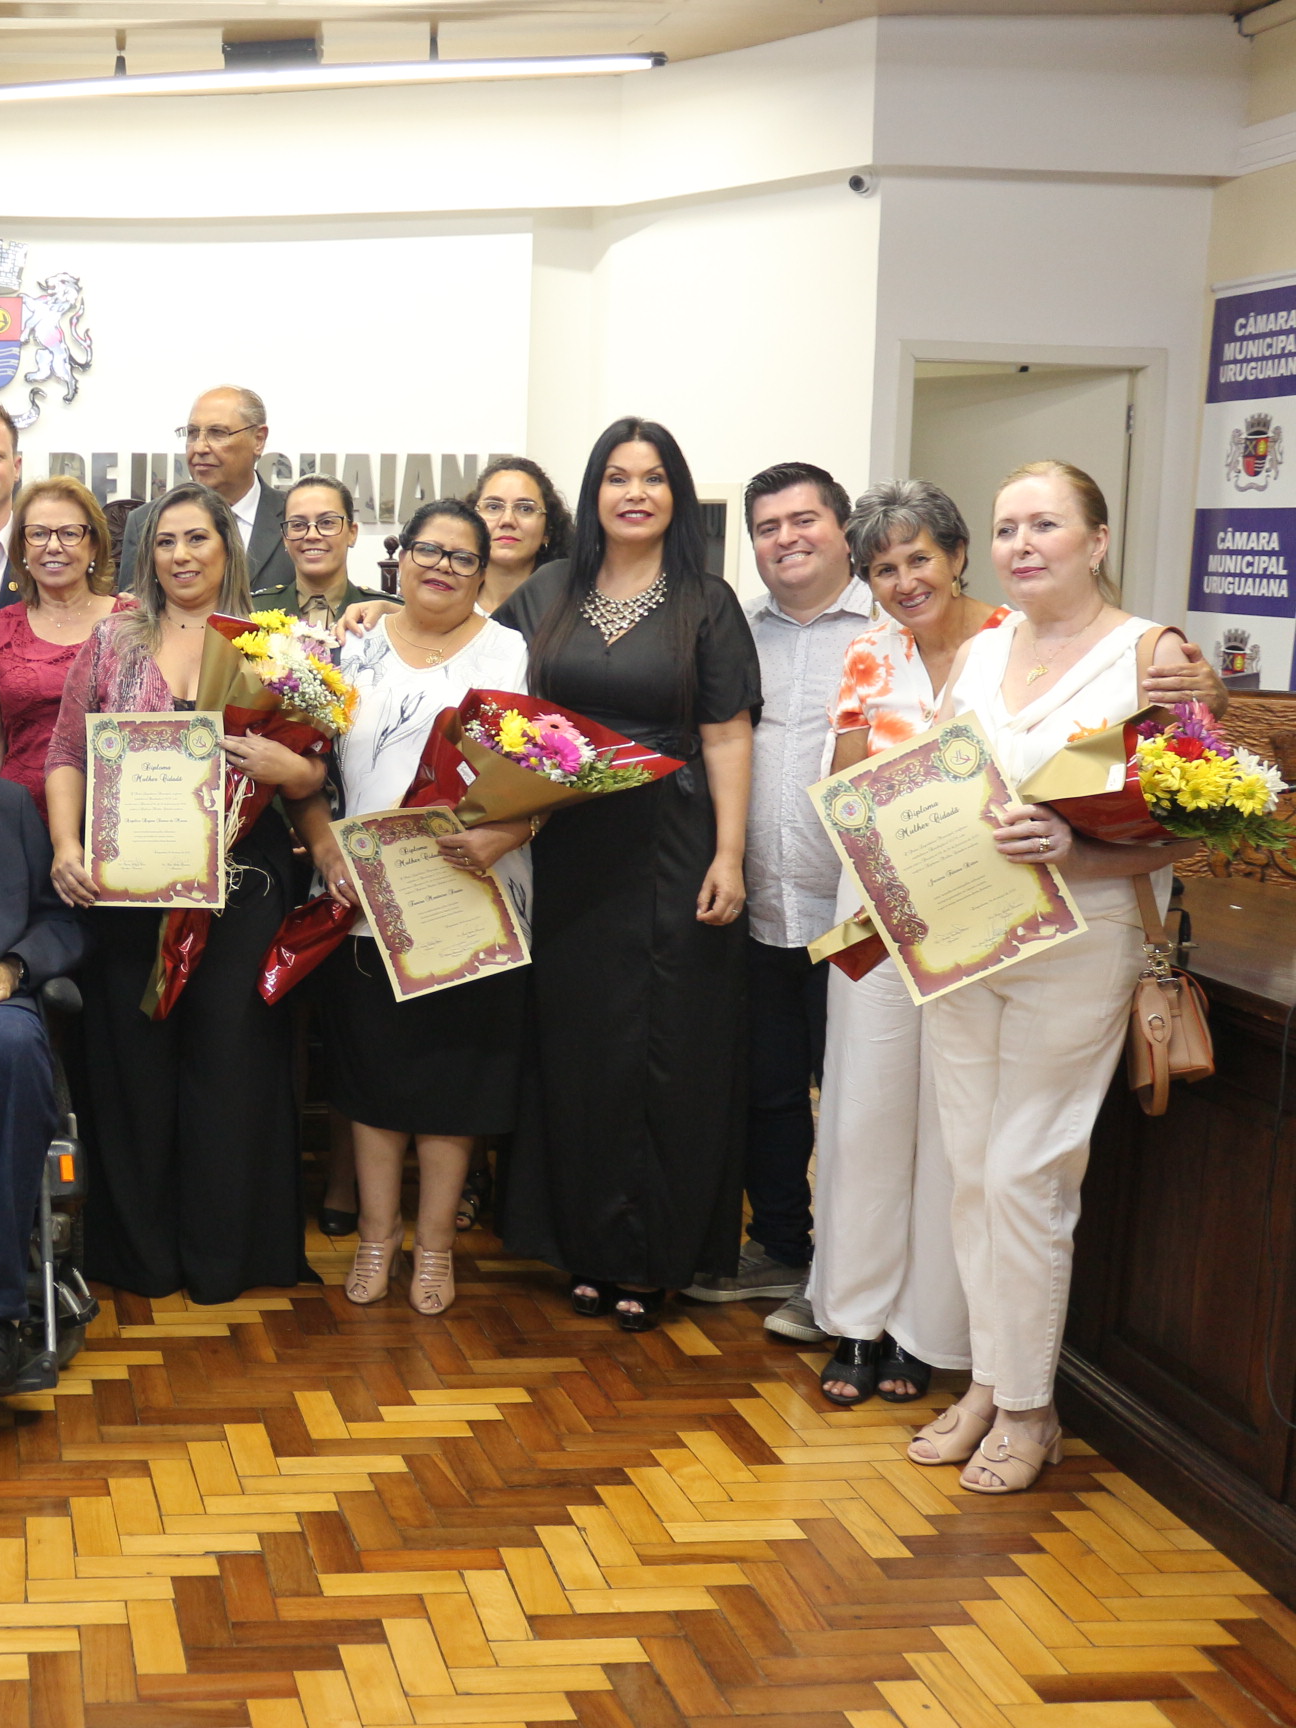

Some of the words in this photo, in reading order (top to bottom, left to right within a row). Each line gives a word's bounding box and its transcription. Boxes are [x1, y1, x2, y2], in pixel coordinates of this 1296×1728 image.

[1234, 311, 1296, 337] CÂMARA
[1223, 334, 1296, 361] MUNICIPA
[1219, 356, 1296, 383] URUGUAIAN
[1217, 527, 1280, 551] CÂMARA
[1207, 554, 1288, 576] MUNICIPAL
[1203, 575, 1289, 598] URUGUAIANA
[900, 801, 939, 822] Diploma
